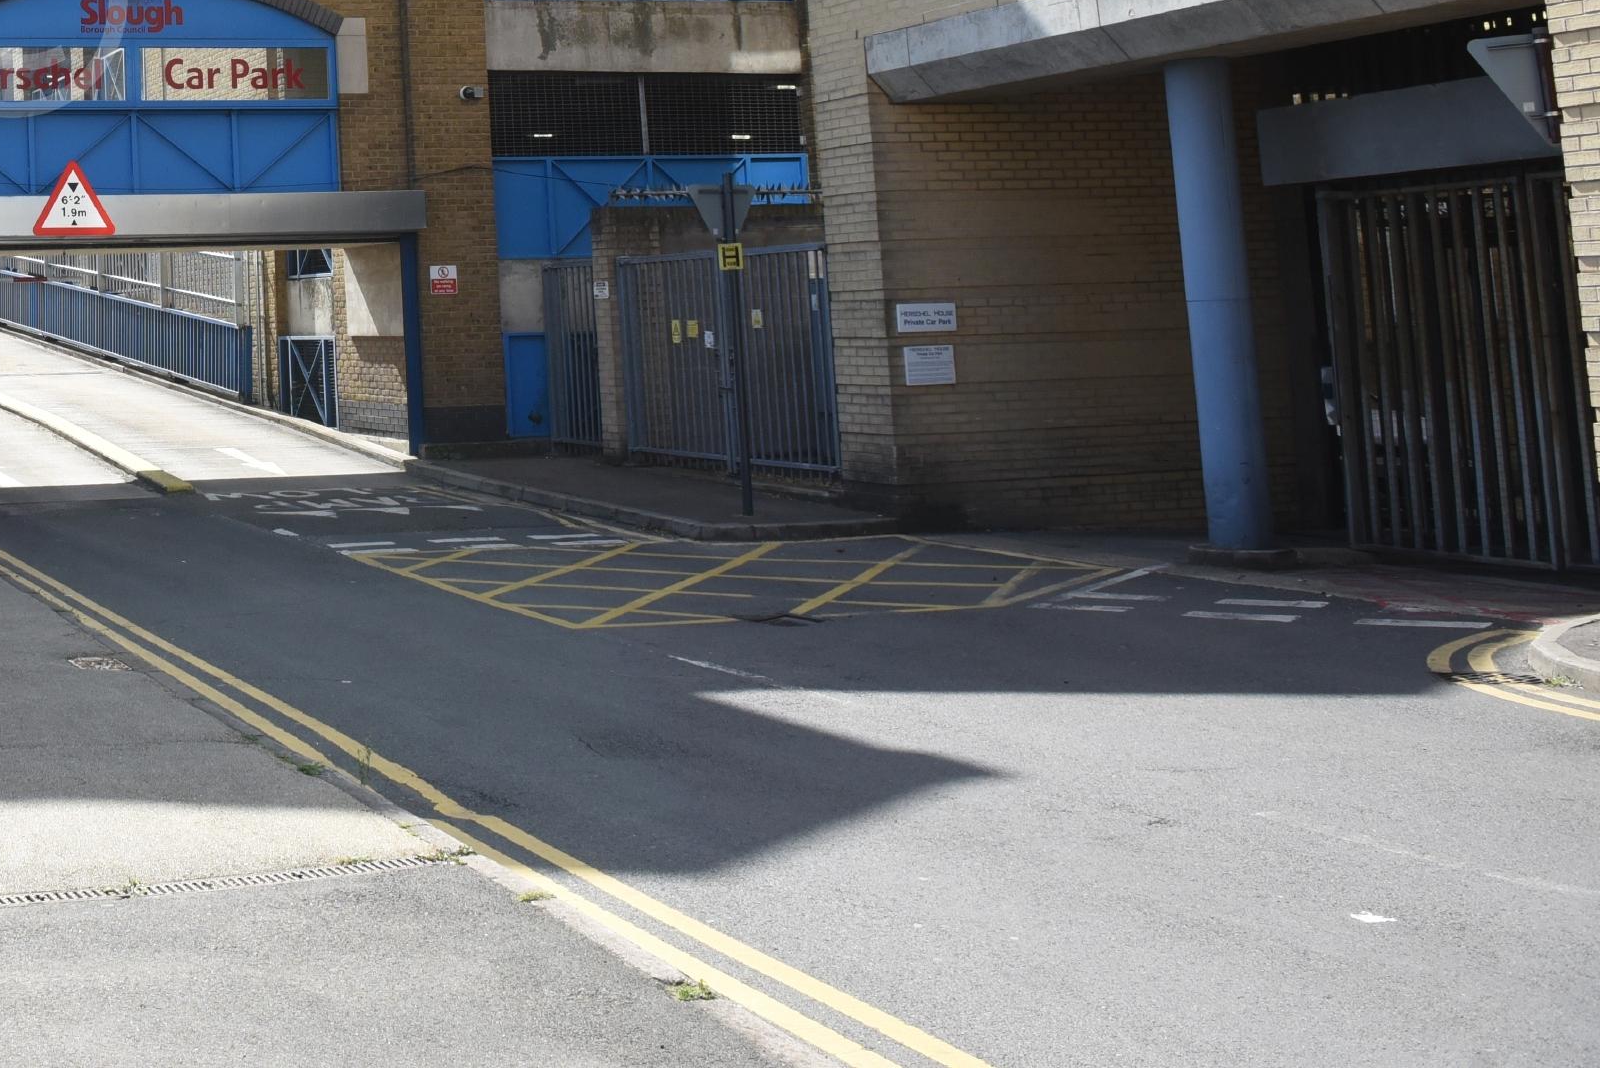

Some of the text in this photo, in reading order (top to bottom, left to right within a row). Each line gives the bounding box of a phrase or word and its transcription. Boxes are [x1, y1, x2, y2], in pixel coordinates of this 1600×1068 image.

[80, 26, 146, 35] Borough Council
[164, 58, 221, 90] Car
[230, 58, 305, 90] Park
[61, 207, 87, 218] 1.9m
